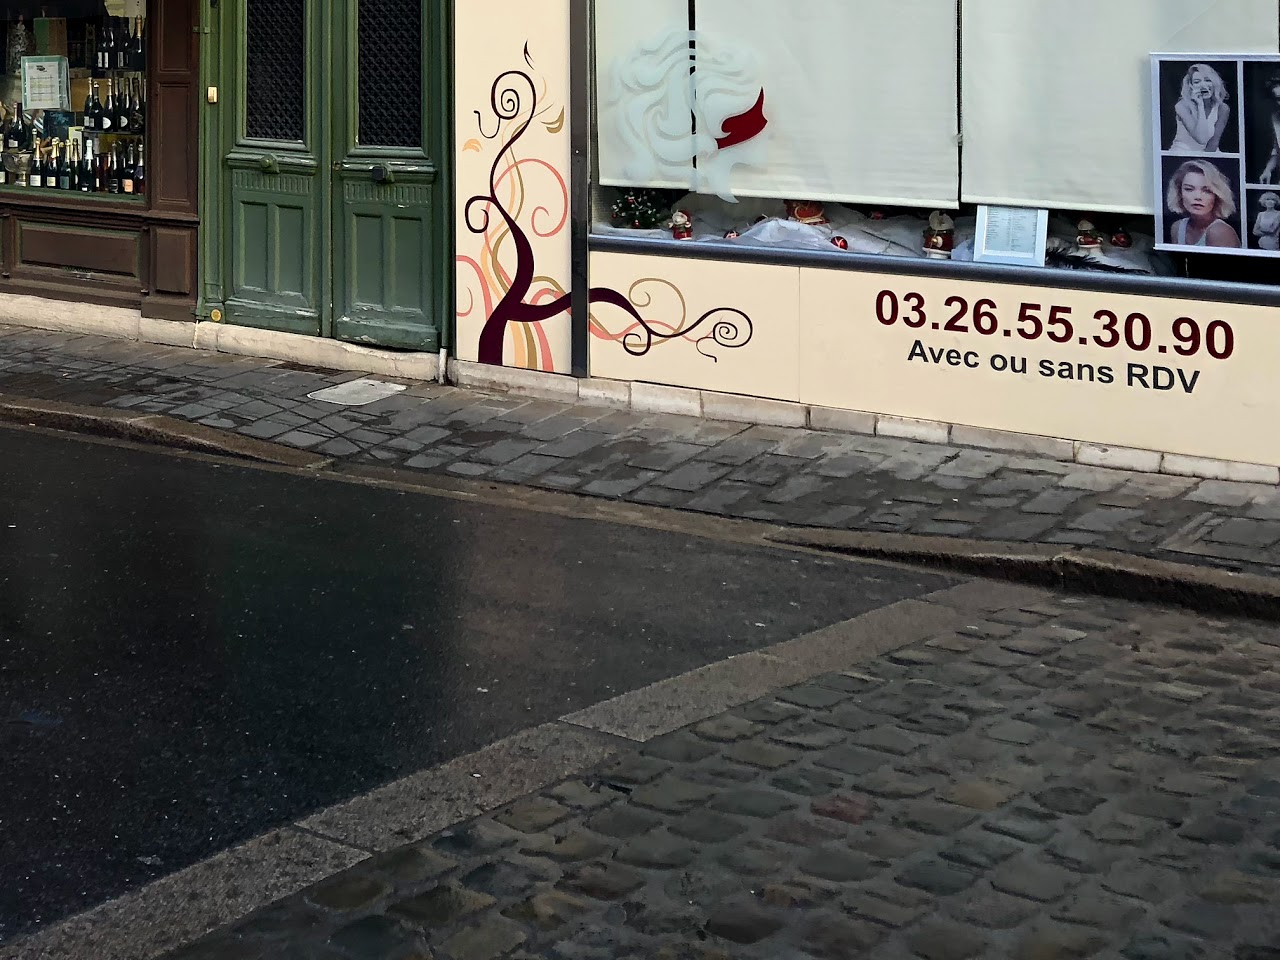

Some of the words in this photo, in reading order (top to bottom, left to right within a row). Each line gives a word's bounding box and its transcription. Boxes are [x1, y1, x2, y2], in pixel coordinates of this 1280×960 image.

[875, 290, 1234, 360] 03.26.55.30.90
[907, 339, 980, 369] Avec
[989, 353, 1027, 374] ou
[1038, 358, 1114, 385] sans
[1127, 362, 1200, 394] RDV
